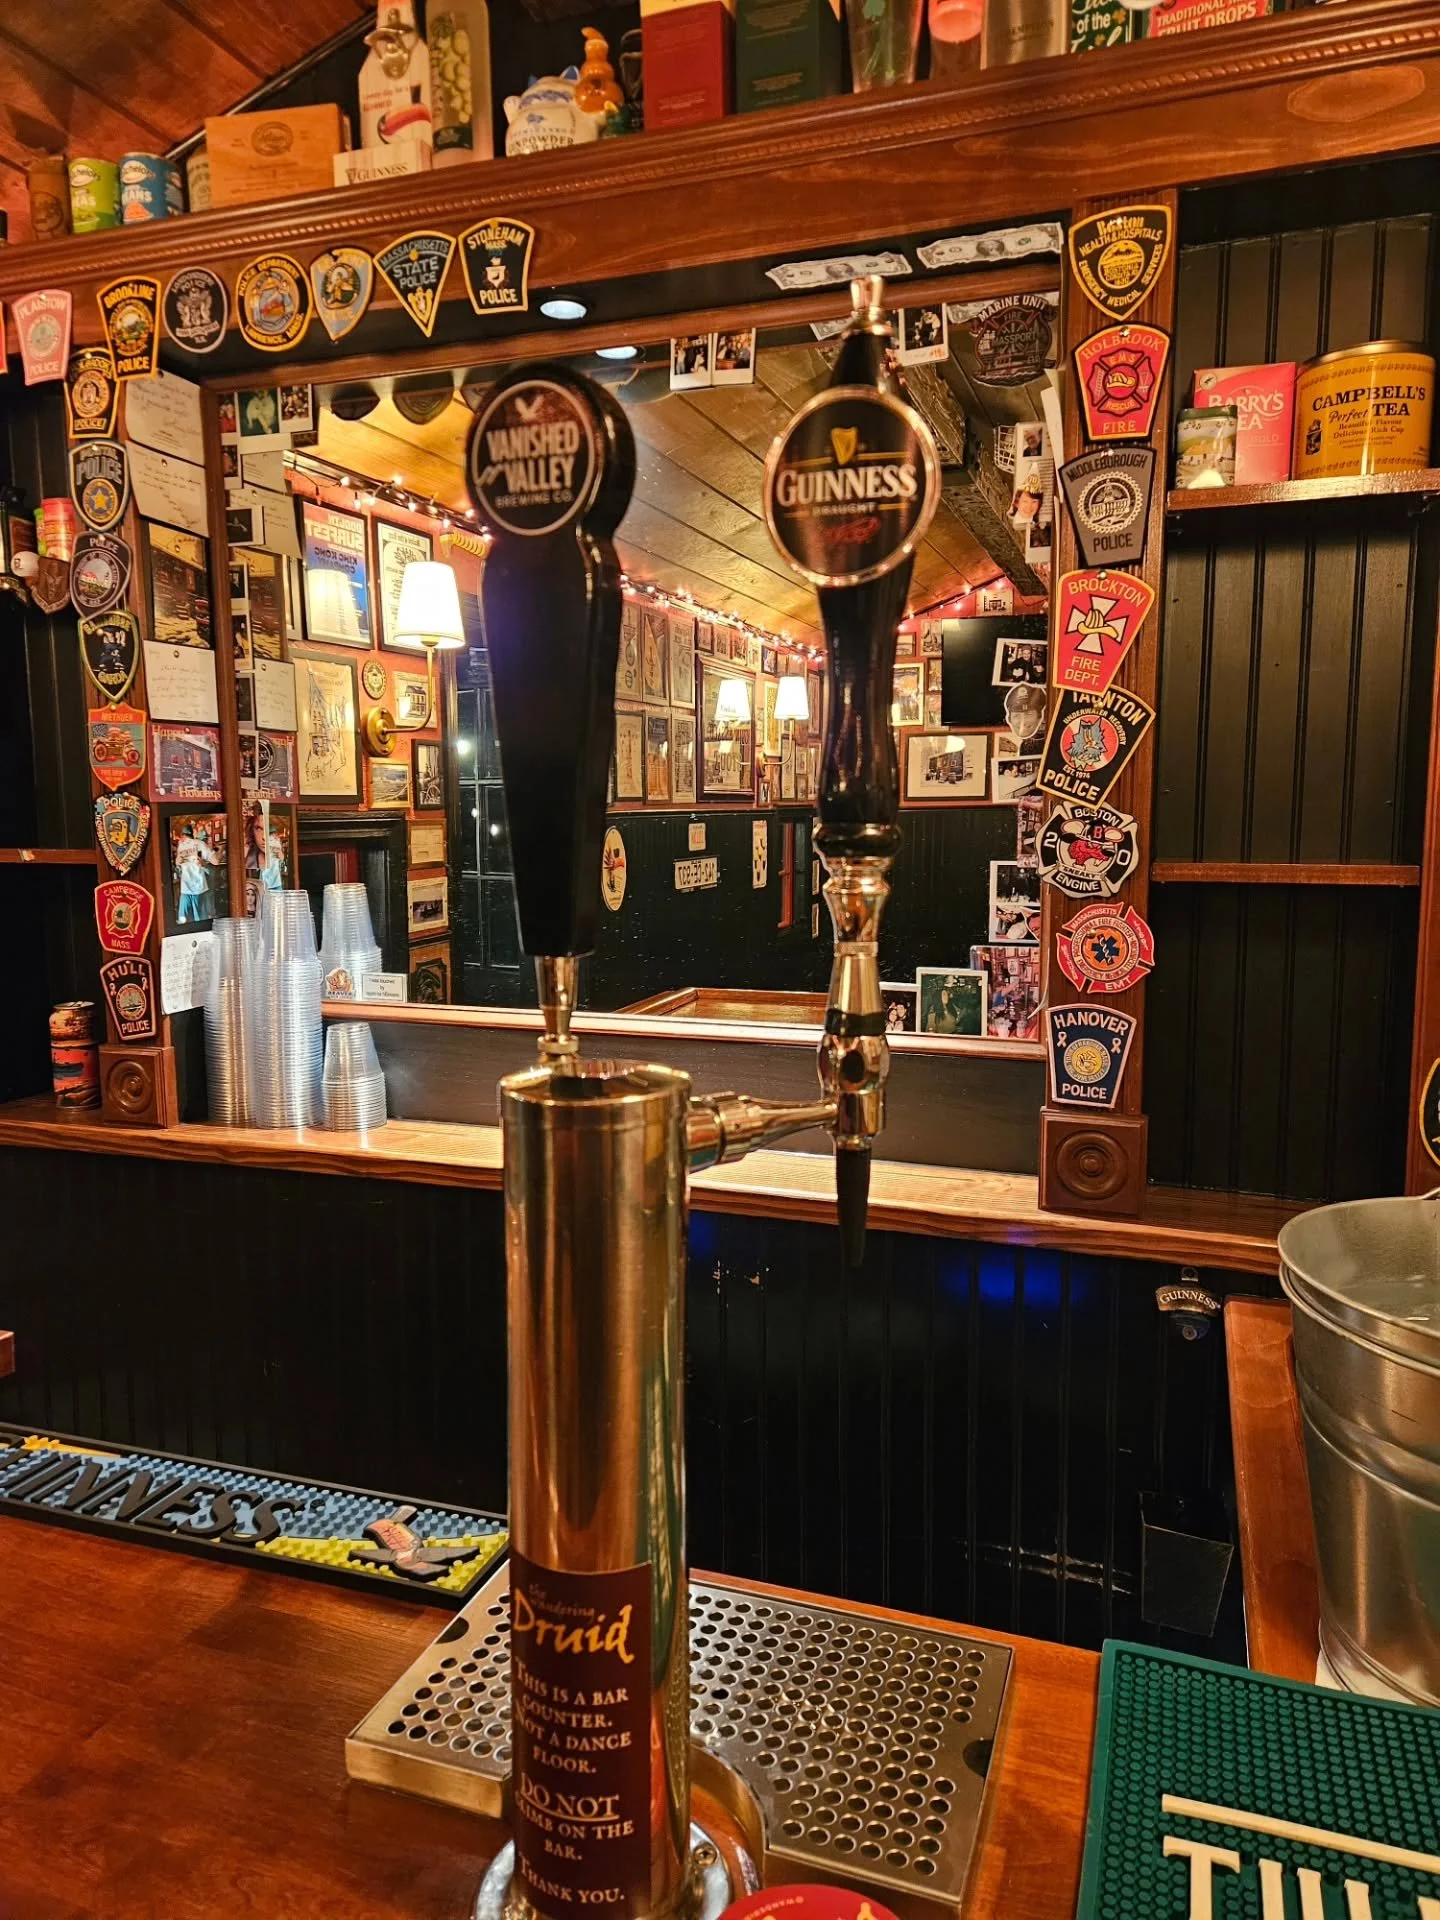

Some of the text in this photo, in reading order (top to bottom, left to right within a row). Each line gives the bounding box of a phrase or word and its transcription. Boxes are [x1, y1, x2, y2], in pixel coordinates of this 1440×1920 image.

[1076, 13, 1089, 34] of
[1091, 12, 1110, 31] the
[1157, 0, 1226, 28] TRADITIONAL
[1204, 2, 1256, 28] DROPS
[357, 163, 408, 181] GUINNESS
[467, 226, 525, 250] STONEHAM
[1079, 232, 1111, 257] HEALTH
[1118, 228, 1163, 242] HOSPITALS
[379, 238, 450, 267] MASSACHUSETTS
[392, 256, 439, 278] STATE
[1107, 289, 1142, 307] MEDICAL
[1141, 243, 1163, 285] SERVICES
[239, 268, 257, 297] POLICE
[399, 271, 437, 290] POLICE
[103, 283, 156, 308] BROOKLINE
[479, 288, 518, 305] POLICE
[18, 298, 67, 319] PLAISTOW
[977, 295, 1049, 322] MARINE UNIT
[1003, 312, 1023, 321] FIRE
[1081, 334, 1164, 360] HOLBROOK
[29, 361, 59, 375] POLICE
[117, 356, 150, 373] POLICE
[1109, 354, 1137, 365] EMS
[1208, 389, 1284, 414] BARRY'S
[1312, 385, 1426, 413] CAMPBELL'S
[75, 418, 105, 429] POLICE
[1237, 413, 1263, 431] EA
[1329, 403, 1410, 424] Perfect TEA
[1102, 420, 1137, 434] FIRE
[1390, 426, 1404, 434] Cup
[486, 420, 580, 462] VANISHED
[76, 456, 123, 485] POLICE
[502, 454, 575, 494] VALLEY
[1066, 453, 1148, 482] MIDDLEBOROUGH
[776, 463, 918, 507] GUINNESS
[495, 492, 550, 509] BREWING
[812, 501, 878, 516] DRAUGHT
[89, 538, 119, 554] POLICE
[1093, 533, 1133, 553] POLICE
[1068, 578, 1146, 608] BROCKTON
[1071, 655, 1102, 671] FIRE
[1065, 669, 1100, 686] DEPT.
[101, 712, 134, 722] METHUEN
[1063, 708, 1127, 746] UNDERWATER RECOVERY
[178, 786, 222, 800] Holidays
[1043, 769, 1101, 801] POLICE
[103, 797, 141, 811] POLICE
[1074, 807, 1120, 826] BOSTON
[1043, 831, 1058, 848] 2
[1055, 872, 1100, 891] ENGINE
[1070, 908, 1117, 929] MASSACHUSETTS
[107, 963, 146, 981] HULL
[1105, 975, 1133, 991] EMT
[121, 1019, 150, 1034] POLICE
[1053, 1011, 1129, 1036] HANOVER
[1062, 1083, 1107, 1100] POLICE
[1159, 1290, 1218, 1310] GUINNESS
[514, 1587, 635, 1665] Druid
[515, 1656, 630, 1706] THIS IS A BAR
[522, 1693, 613, 1728] COUNTER.
[513, 1703, 632, 1752] NOT A DANCE
[532, 1745, 597, 1774] FLOOR.
[520, 1772, 620, 1818] DO NOT
[558, 1821, 586, 1840] ON
[592, 1819, 635, 1840] THE
[544, 1838, 584, 1861] BAR.
[519, 1852, 624, 1904] THANK YOU.
